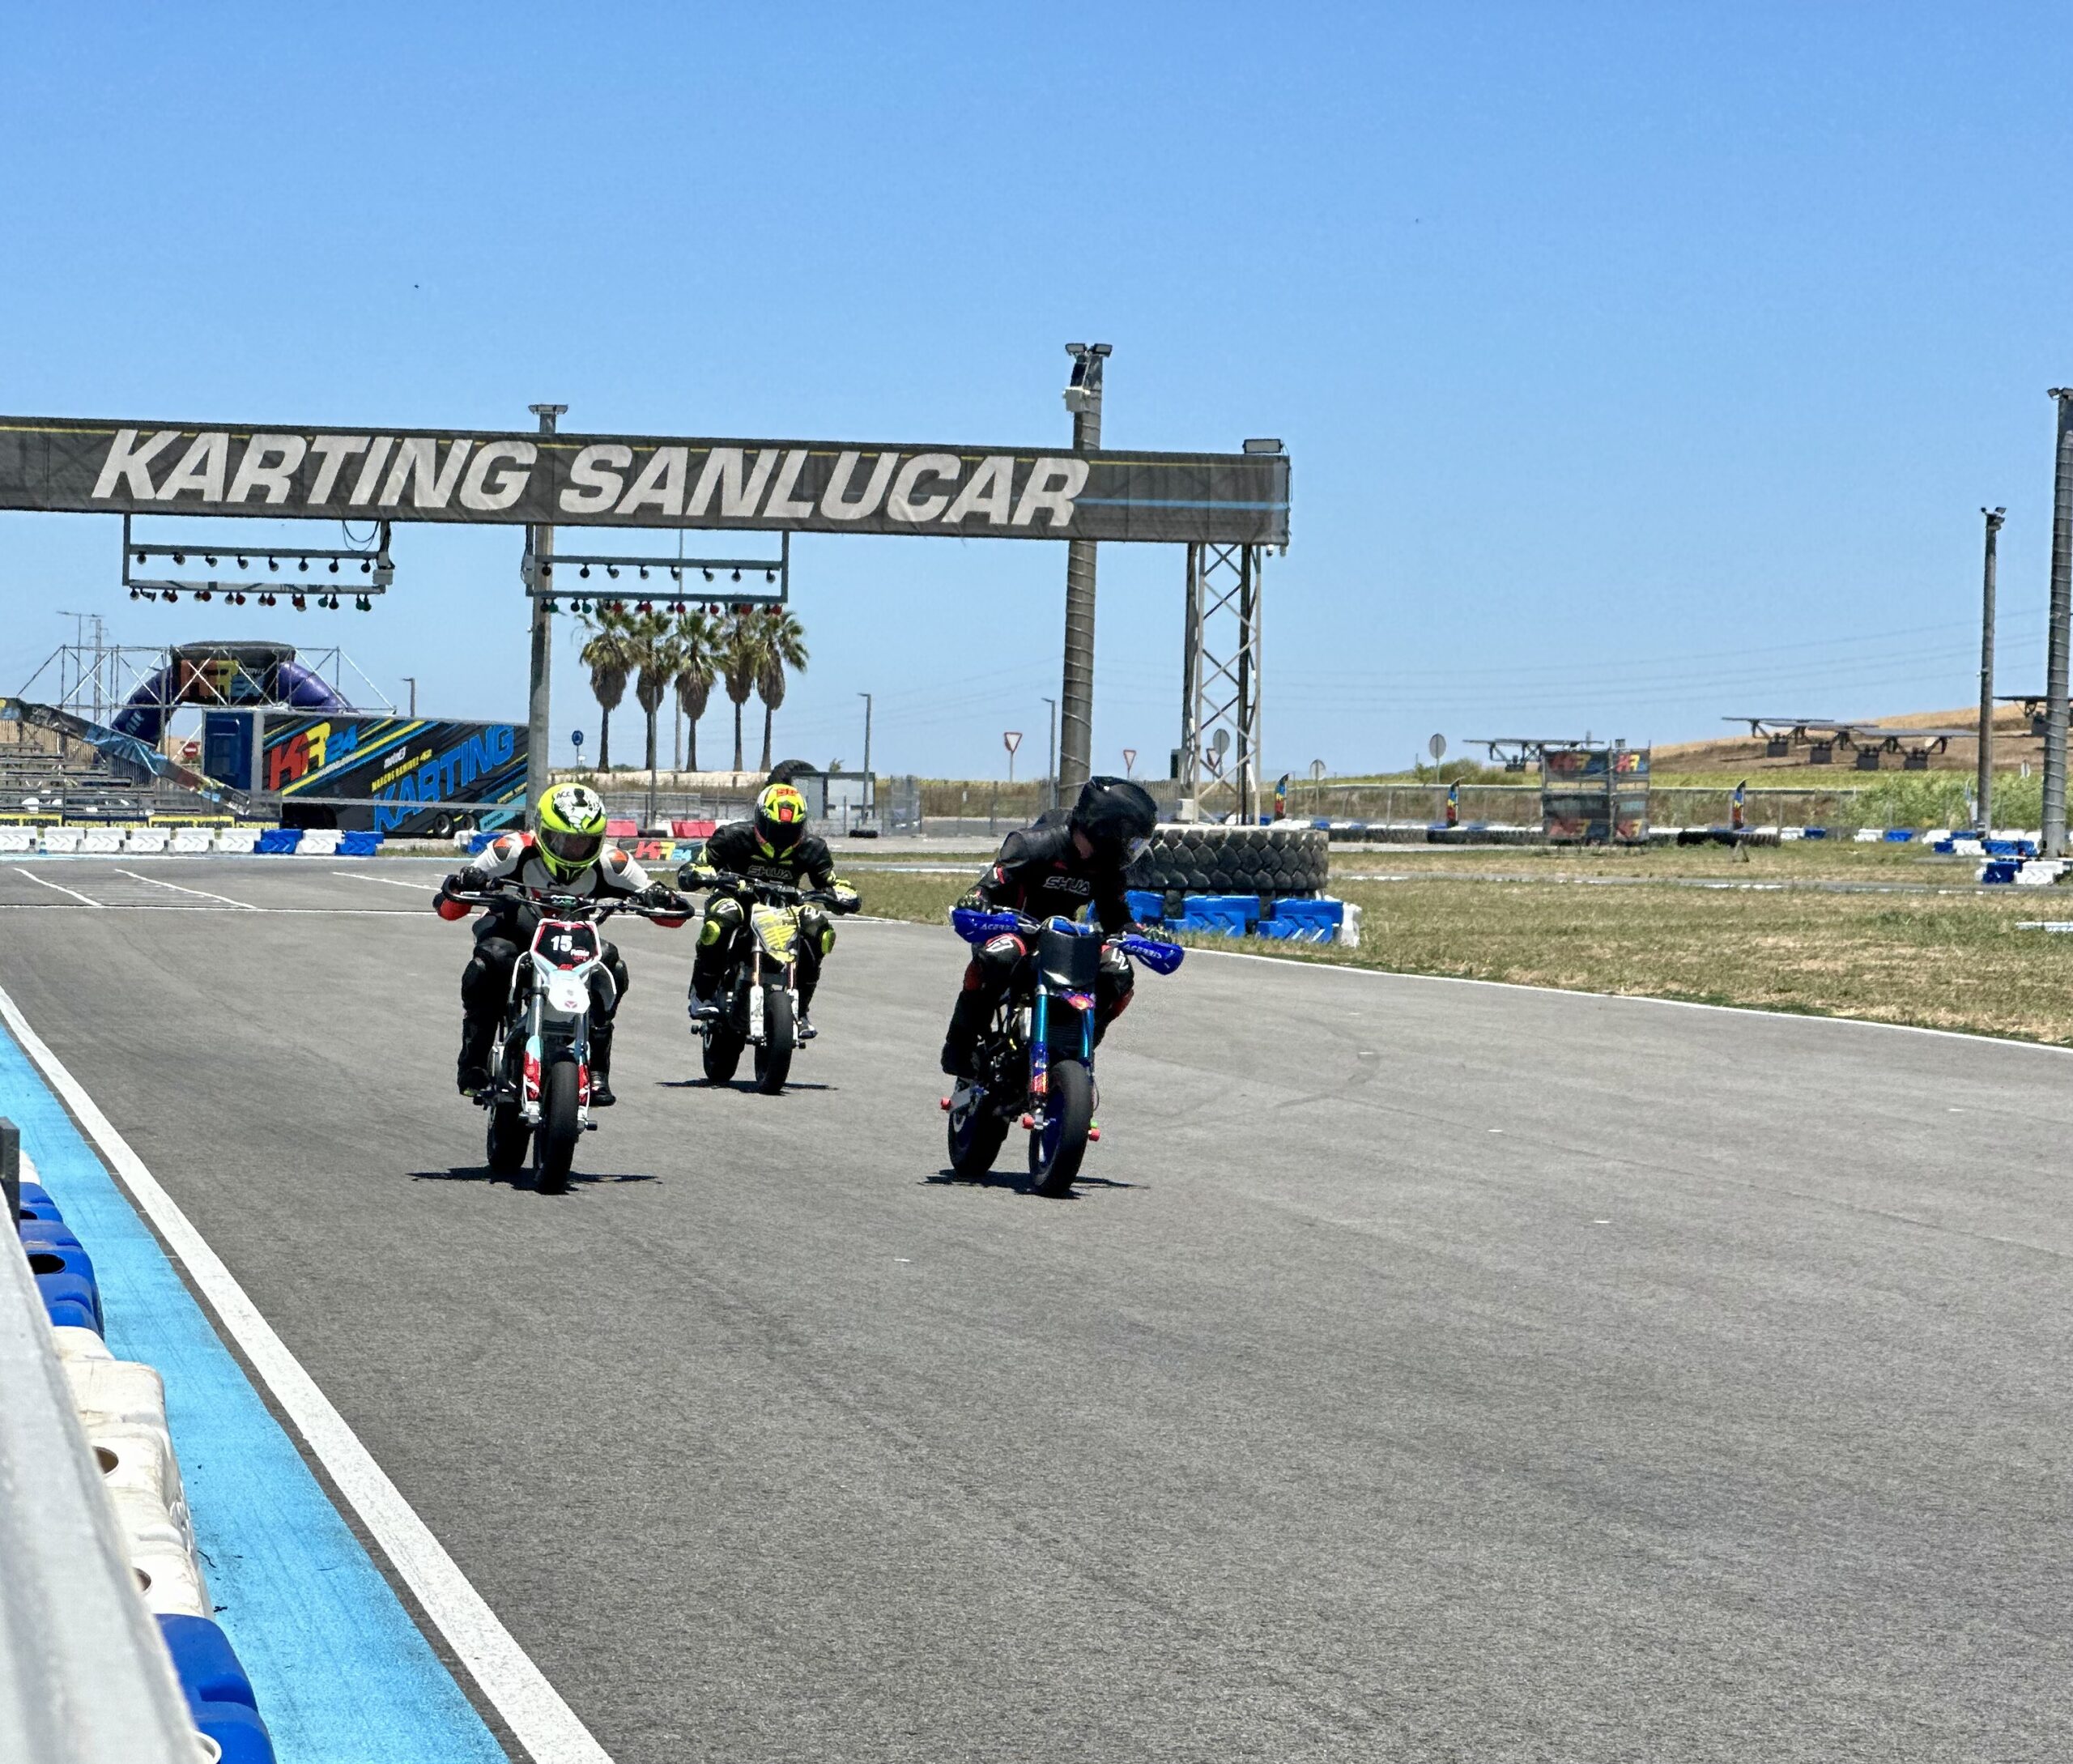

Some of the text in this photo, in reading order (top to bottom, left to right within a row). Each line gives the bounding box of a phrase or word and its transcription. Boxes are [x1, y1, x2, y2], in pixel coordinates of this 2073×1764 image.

[91, 429, 1091, 527] KARTING SANLUCAR
[373, 724, 516, 833] KARTING
[551, 935, 573, 952] 15
